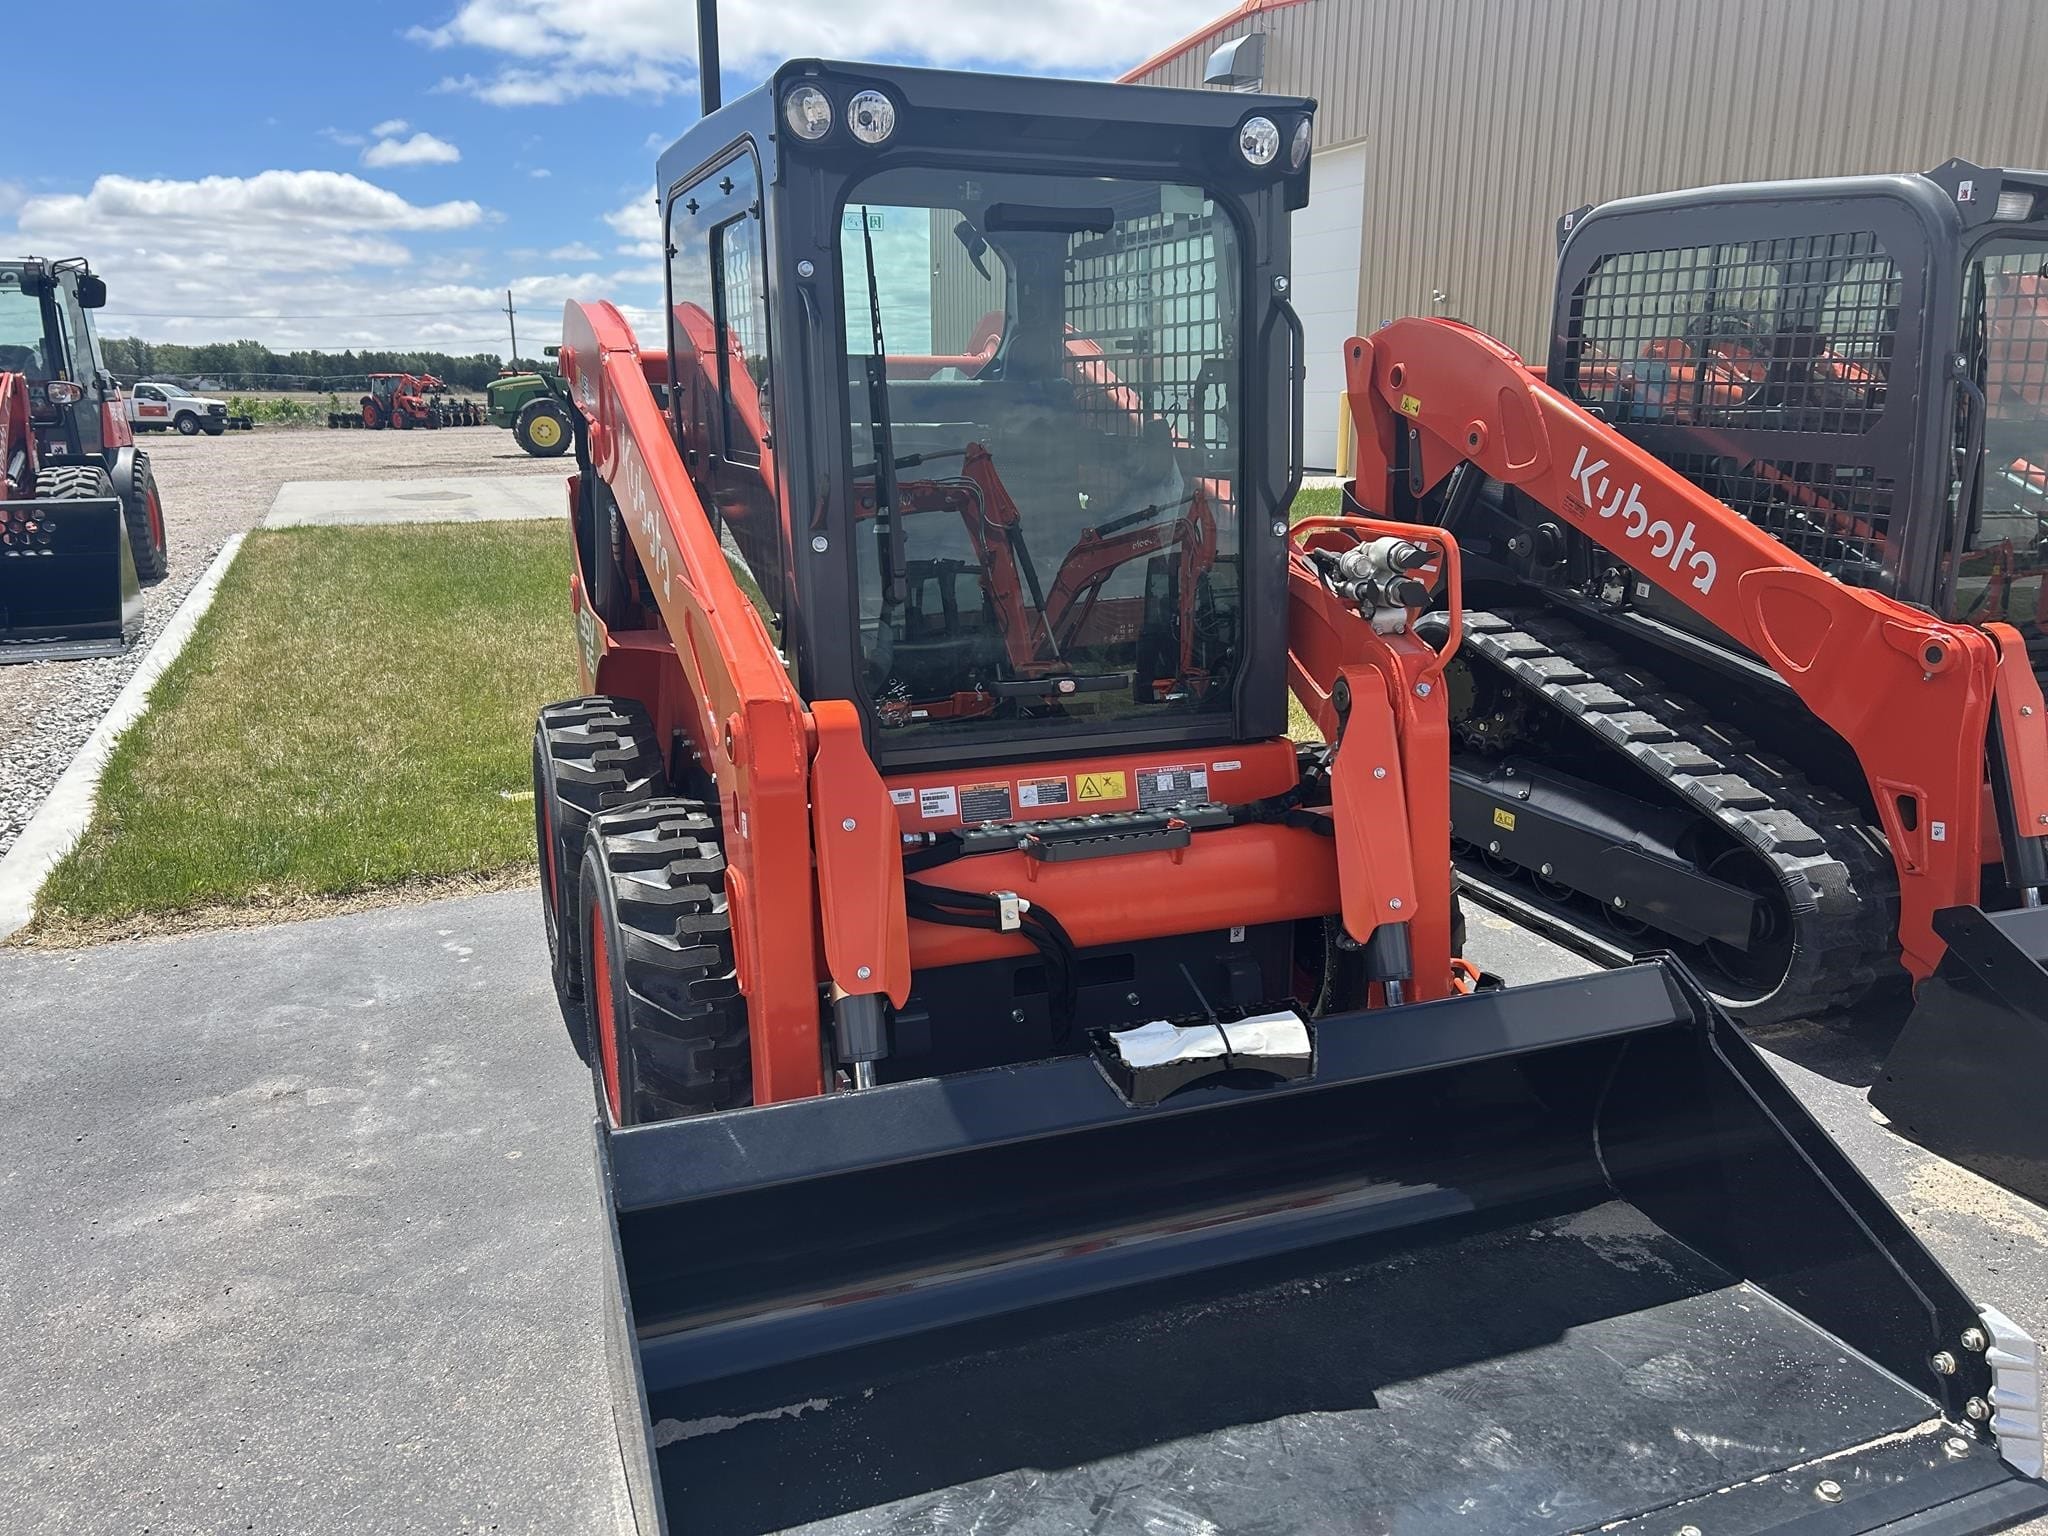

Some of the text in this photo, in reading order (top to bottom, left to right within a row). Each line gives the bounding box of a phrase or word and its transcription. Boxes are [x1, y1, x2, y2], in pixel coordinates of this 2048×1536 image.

[622, 423, 670, 603] Kubota
[1570, 446, 1717, 596] Kubota
[580, 606, 595, 648] SSV
